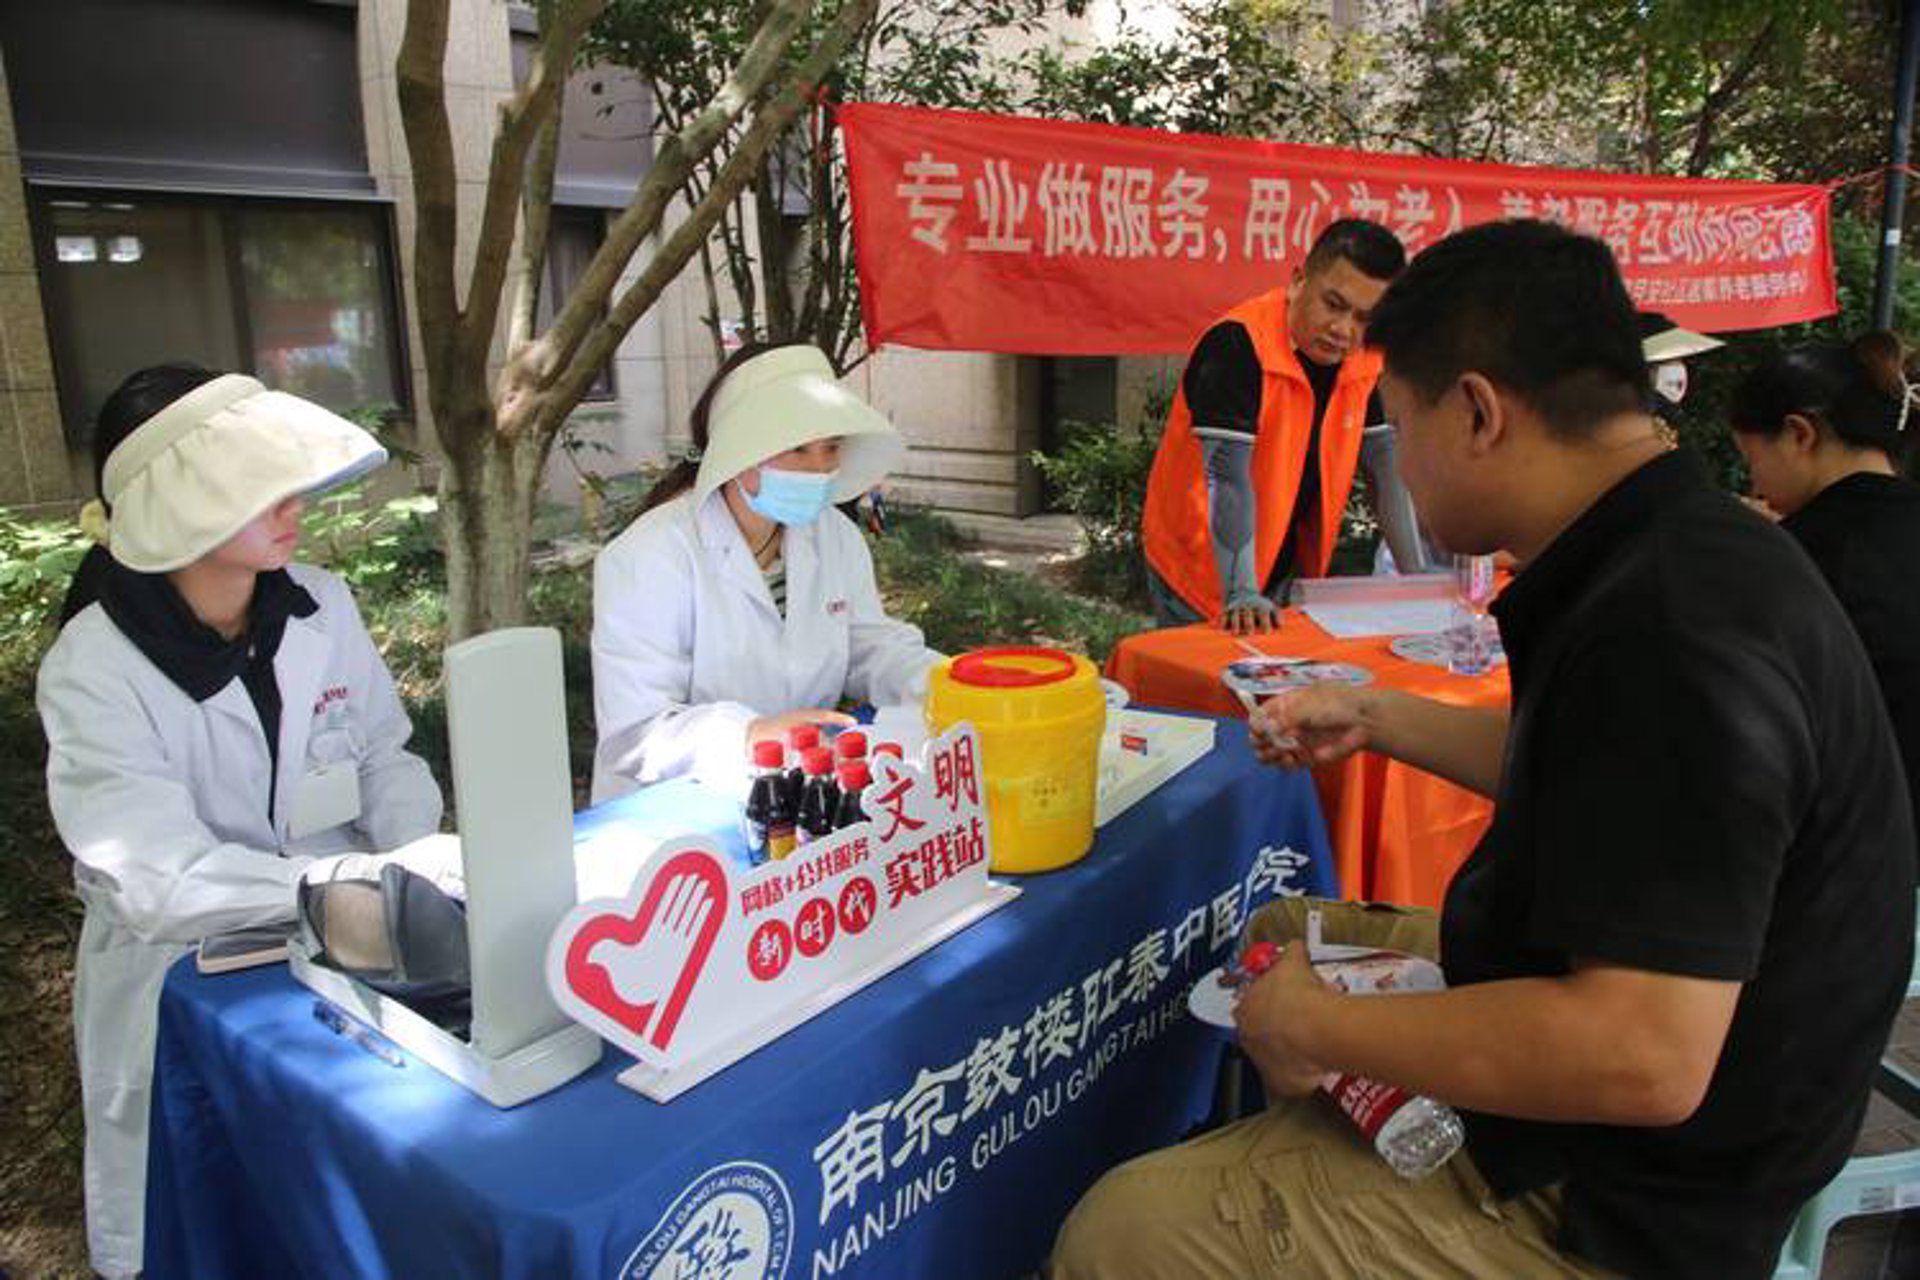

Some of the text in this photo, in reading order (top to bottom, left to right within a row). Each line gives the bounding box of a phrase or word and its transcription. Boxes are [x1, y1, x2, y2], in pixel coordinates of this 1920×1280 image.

[873, 735, 979, 842] 文明
[885, 816, 985, 909] 实践站
[811, 846, 1310, 1226] 南京鼓楼肛泰中医院
[812, 1155, 957, 1280] NANJING
[972, 1080, 1062, 1169] GULOU
[1066, 1009, 1156, 1101] GANGTAI
